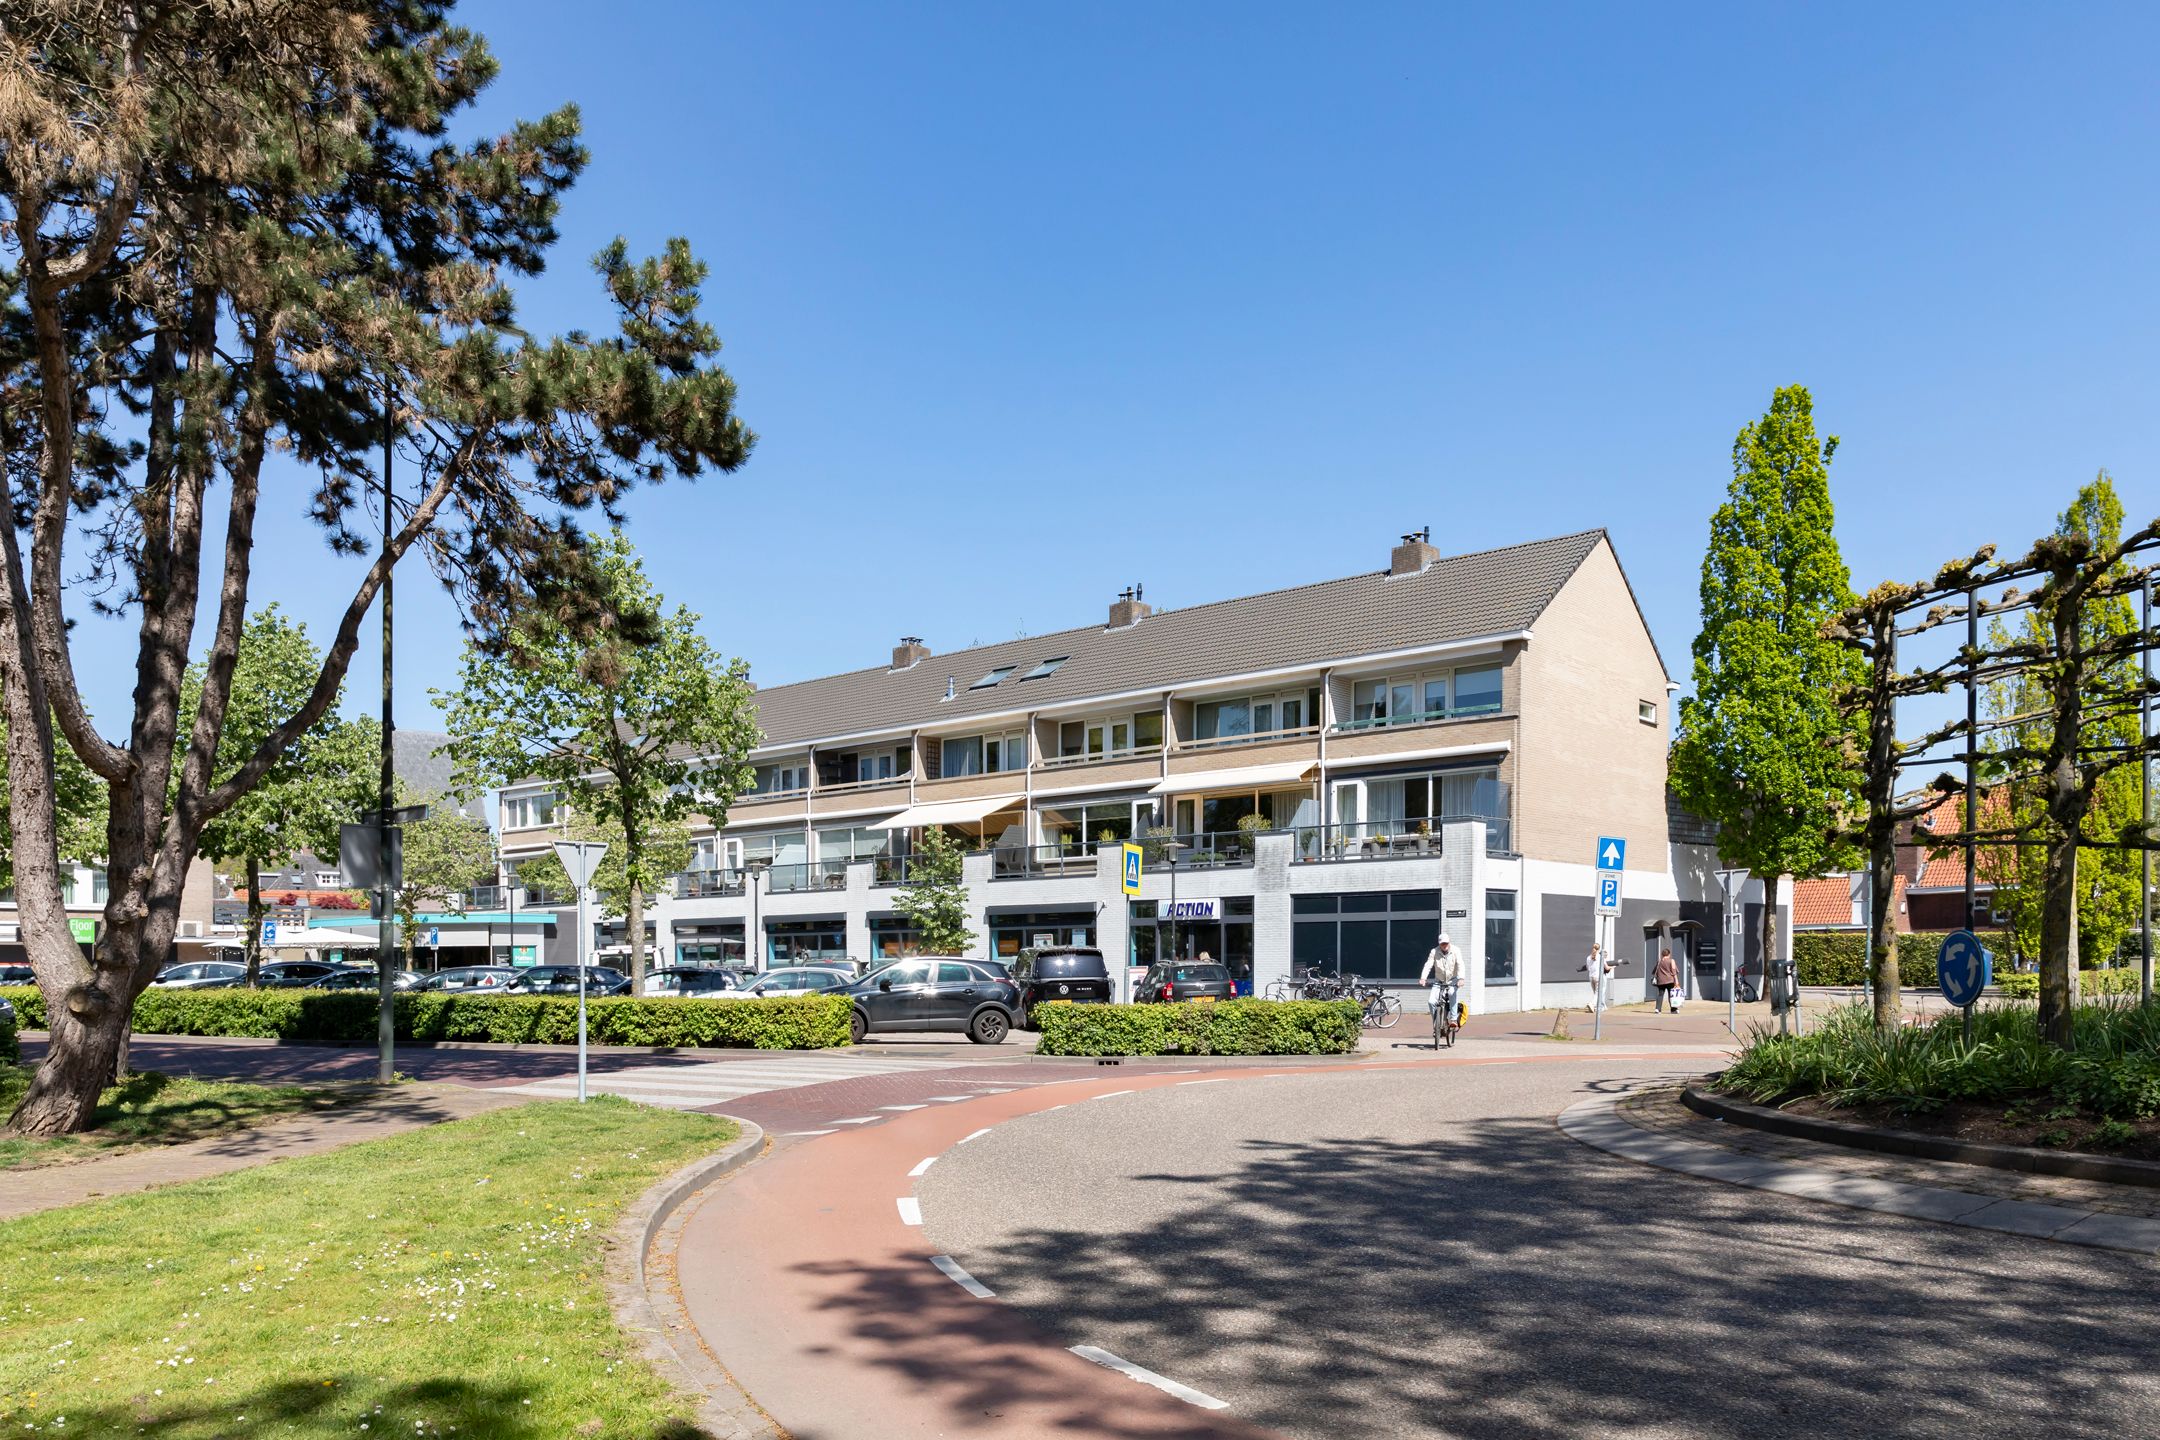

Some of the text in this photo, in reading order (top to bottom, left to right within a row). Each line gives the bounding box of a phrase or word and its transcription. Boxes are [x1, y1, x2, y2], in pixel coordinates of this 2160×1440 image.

[1604, 881, 1615, 896] P
[1166, 902, 1214, 917] ACTION
[69, 919, 92, 931] Floor
